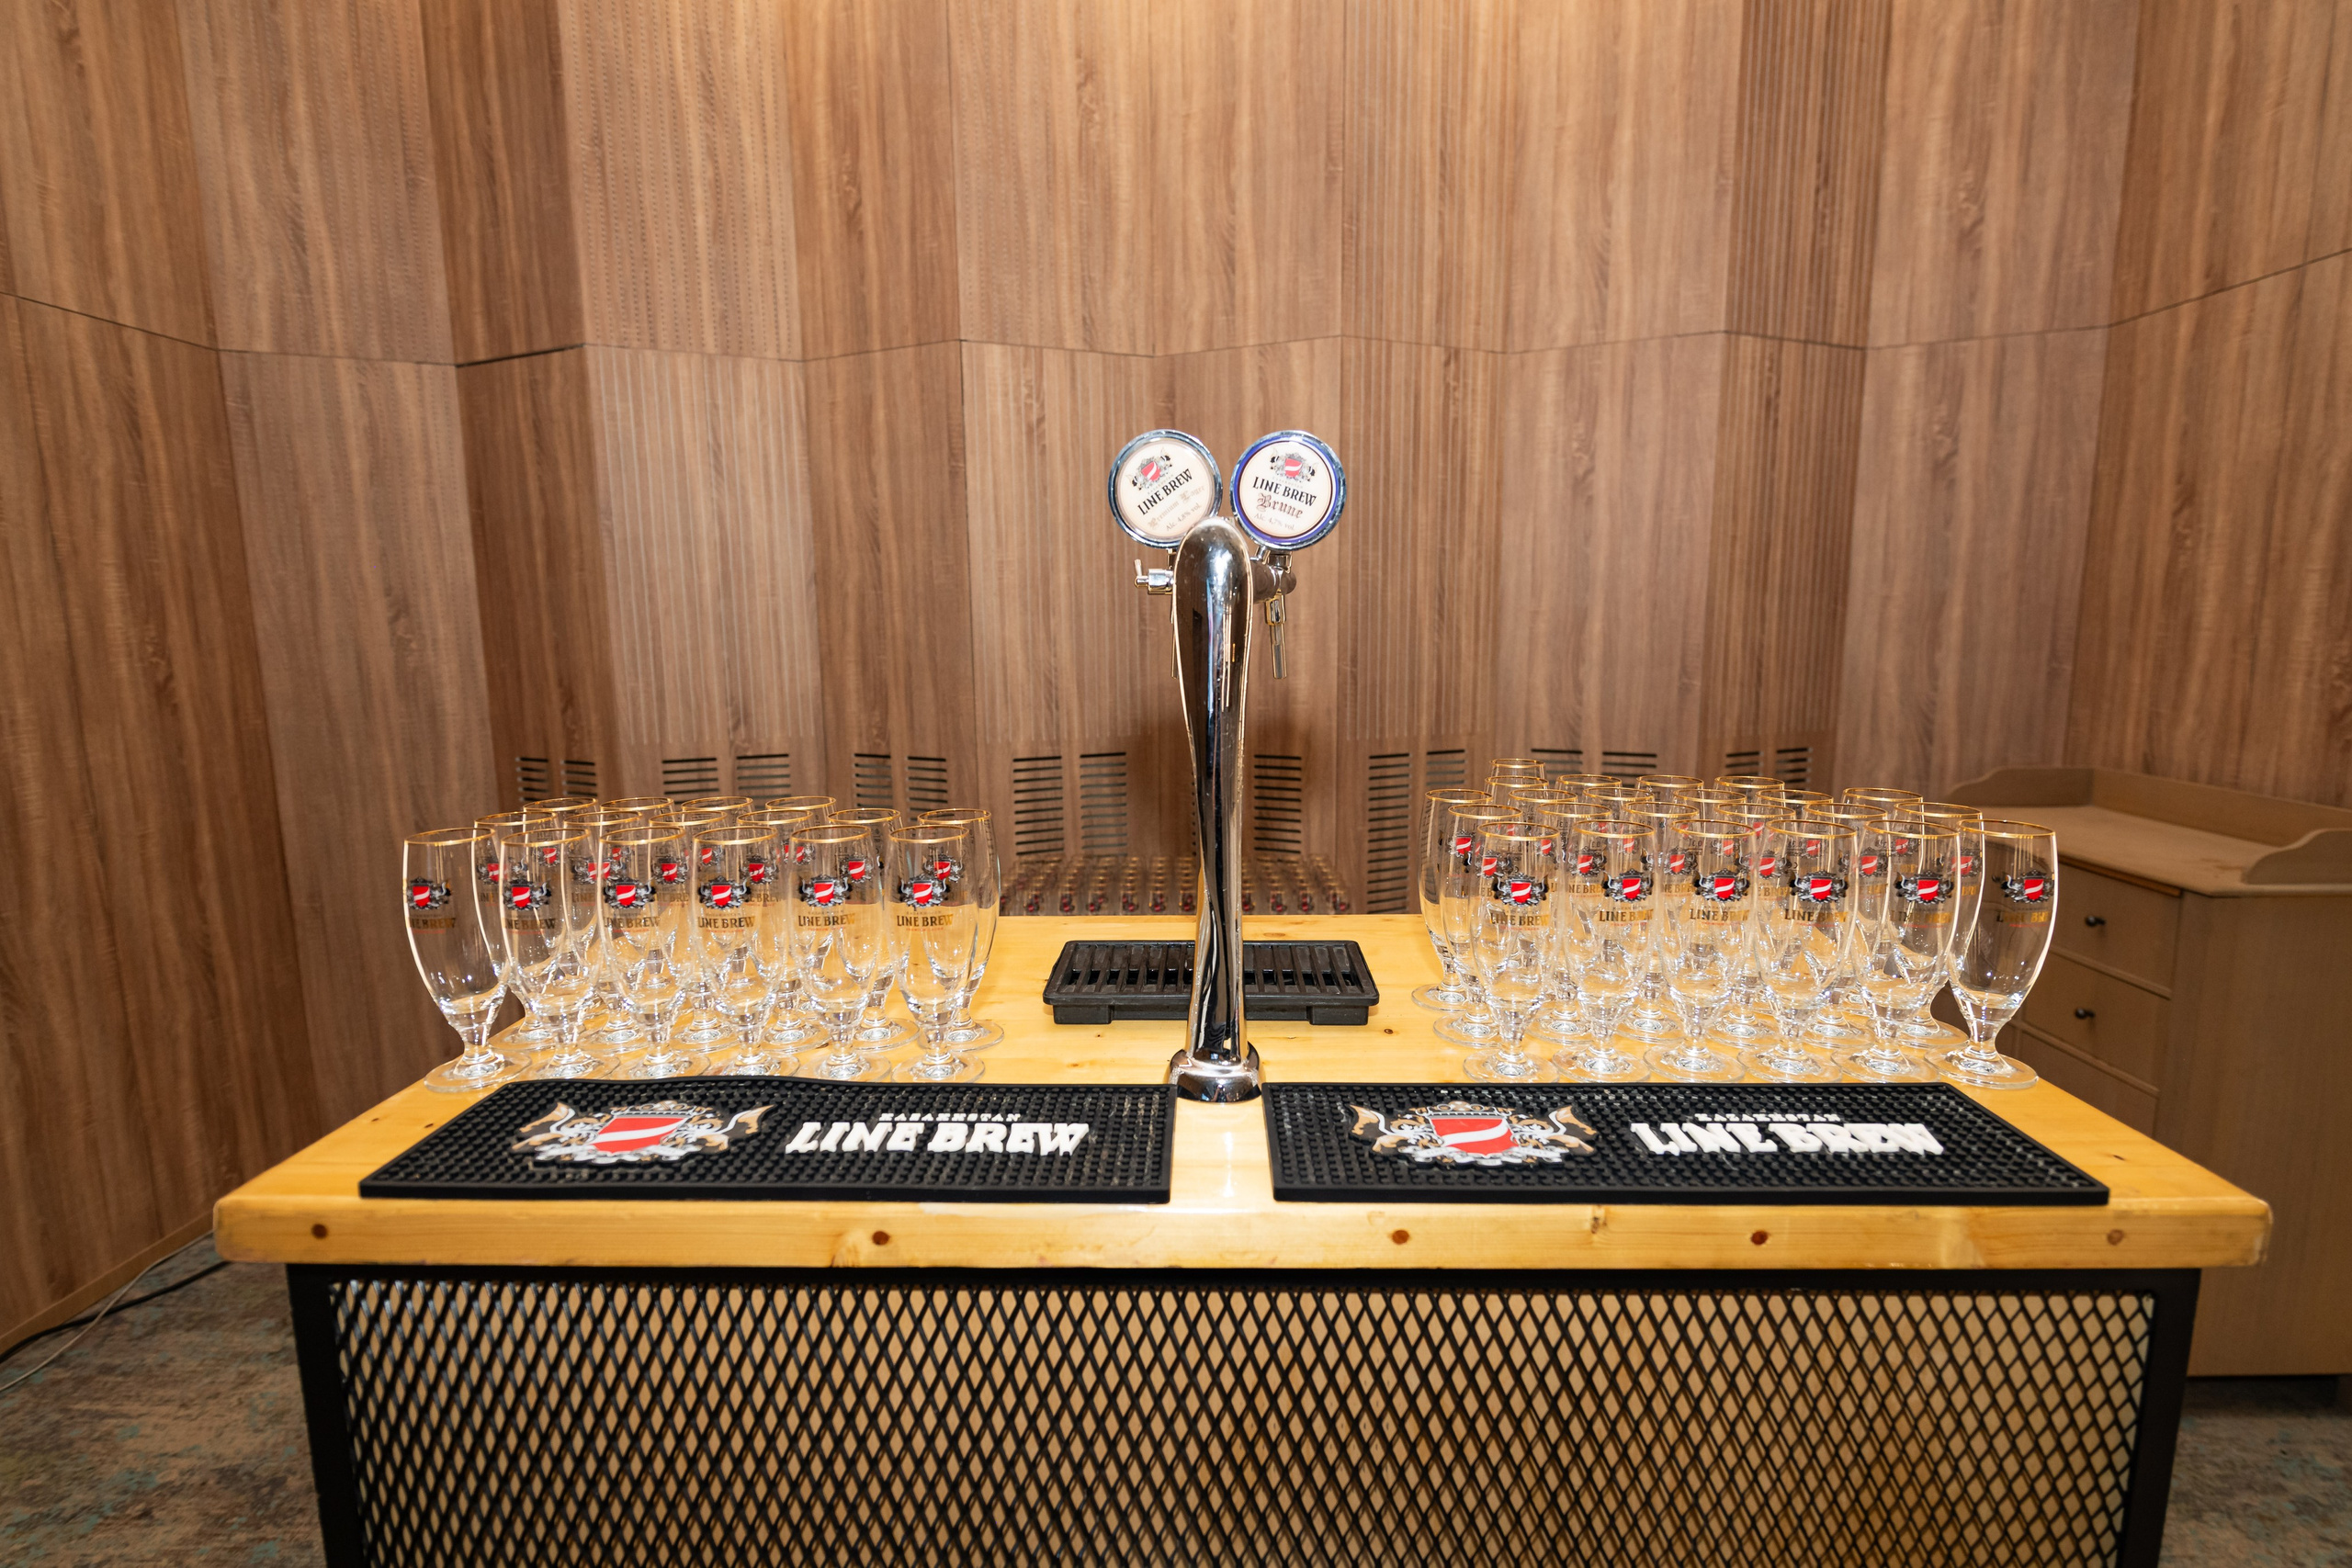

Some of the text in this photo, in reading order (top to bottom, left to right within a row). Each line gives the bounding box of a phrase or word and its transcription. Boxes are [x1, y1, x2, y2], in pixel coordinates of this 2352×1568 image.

[1137, 468, 1193, 515] LINE BREW
[1252, 476, 1282, 494] LINE
[1282, 486, 1317, 506] BREW
[1256, 492, 1303, 519] Brune
[798, 913, 855, 927] LINE BREW
[897, 914, 954, 927] LINE BREW
[1519, 914, 1550, 926] BREW
[1599, 910, 1626, 922] LINE
[1690, 908, 1718, 921] LINE
[1785, 908, 1815, 922] LINE
[722, 916, 755, 929] BREW
[785, 1122, 1090, 1156] LINE BREW
[1631, 1122, 1944, 1156] LINE BREW
